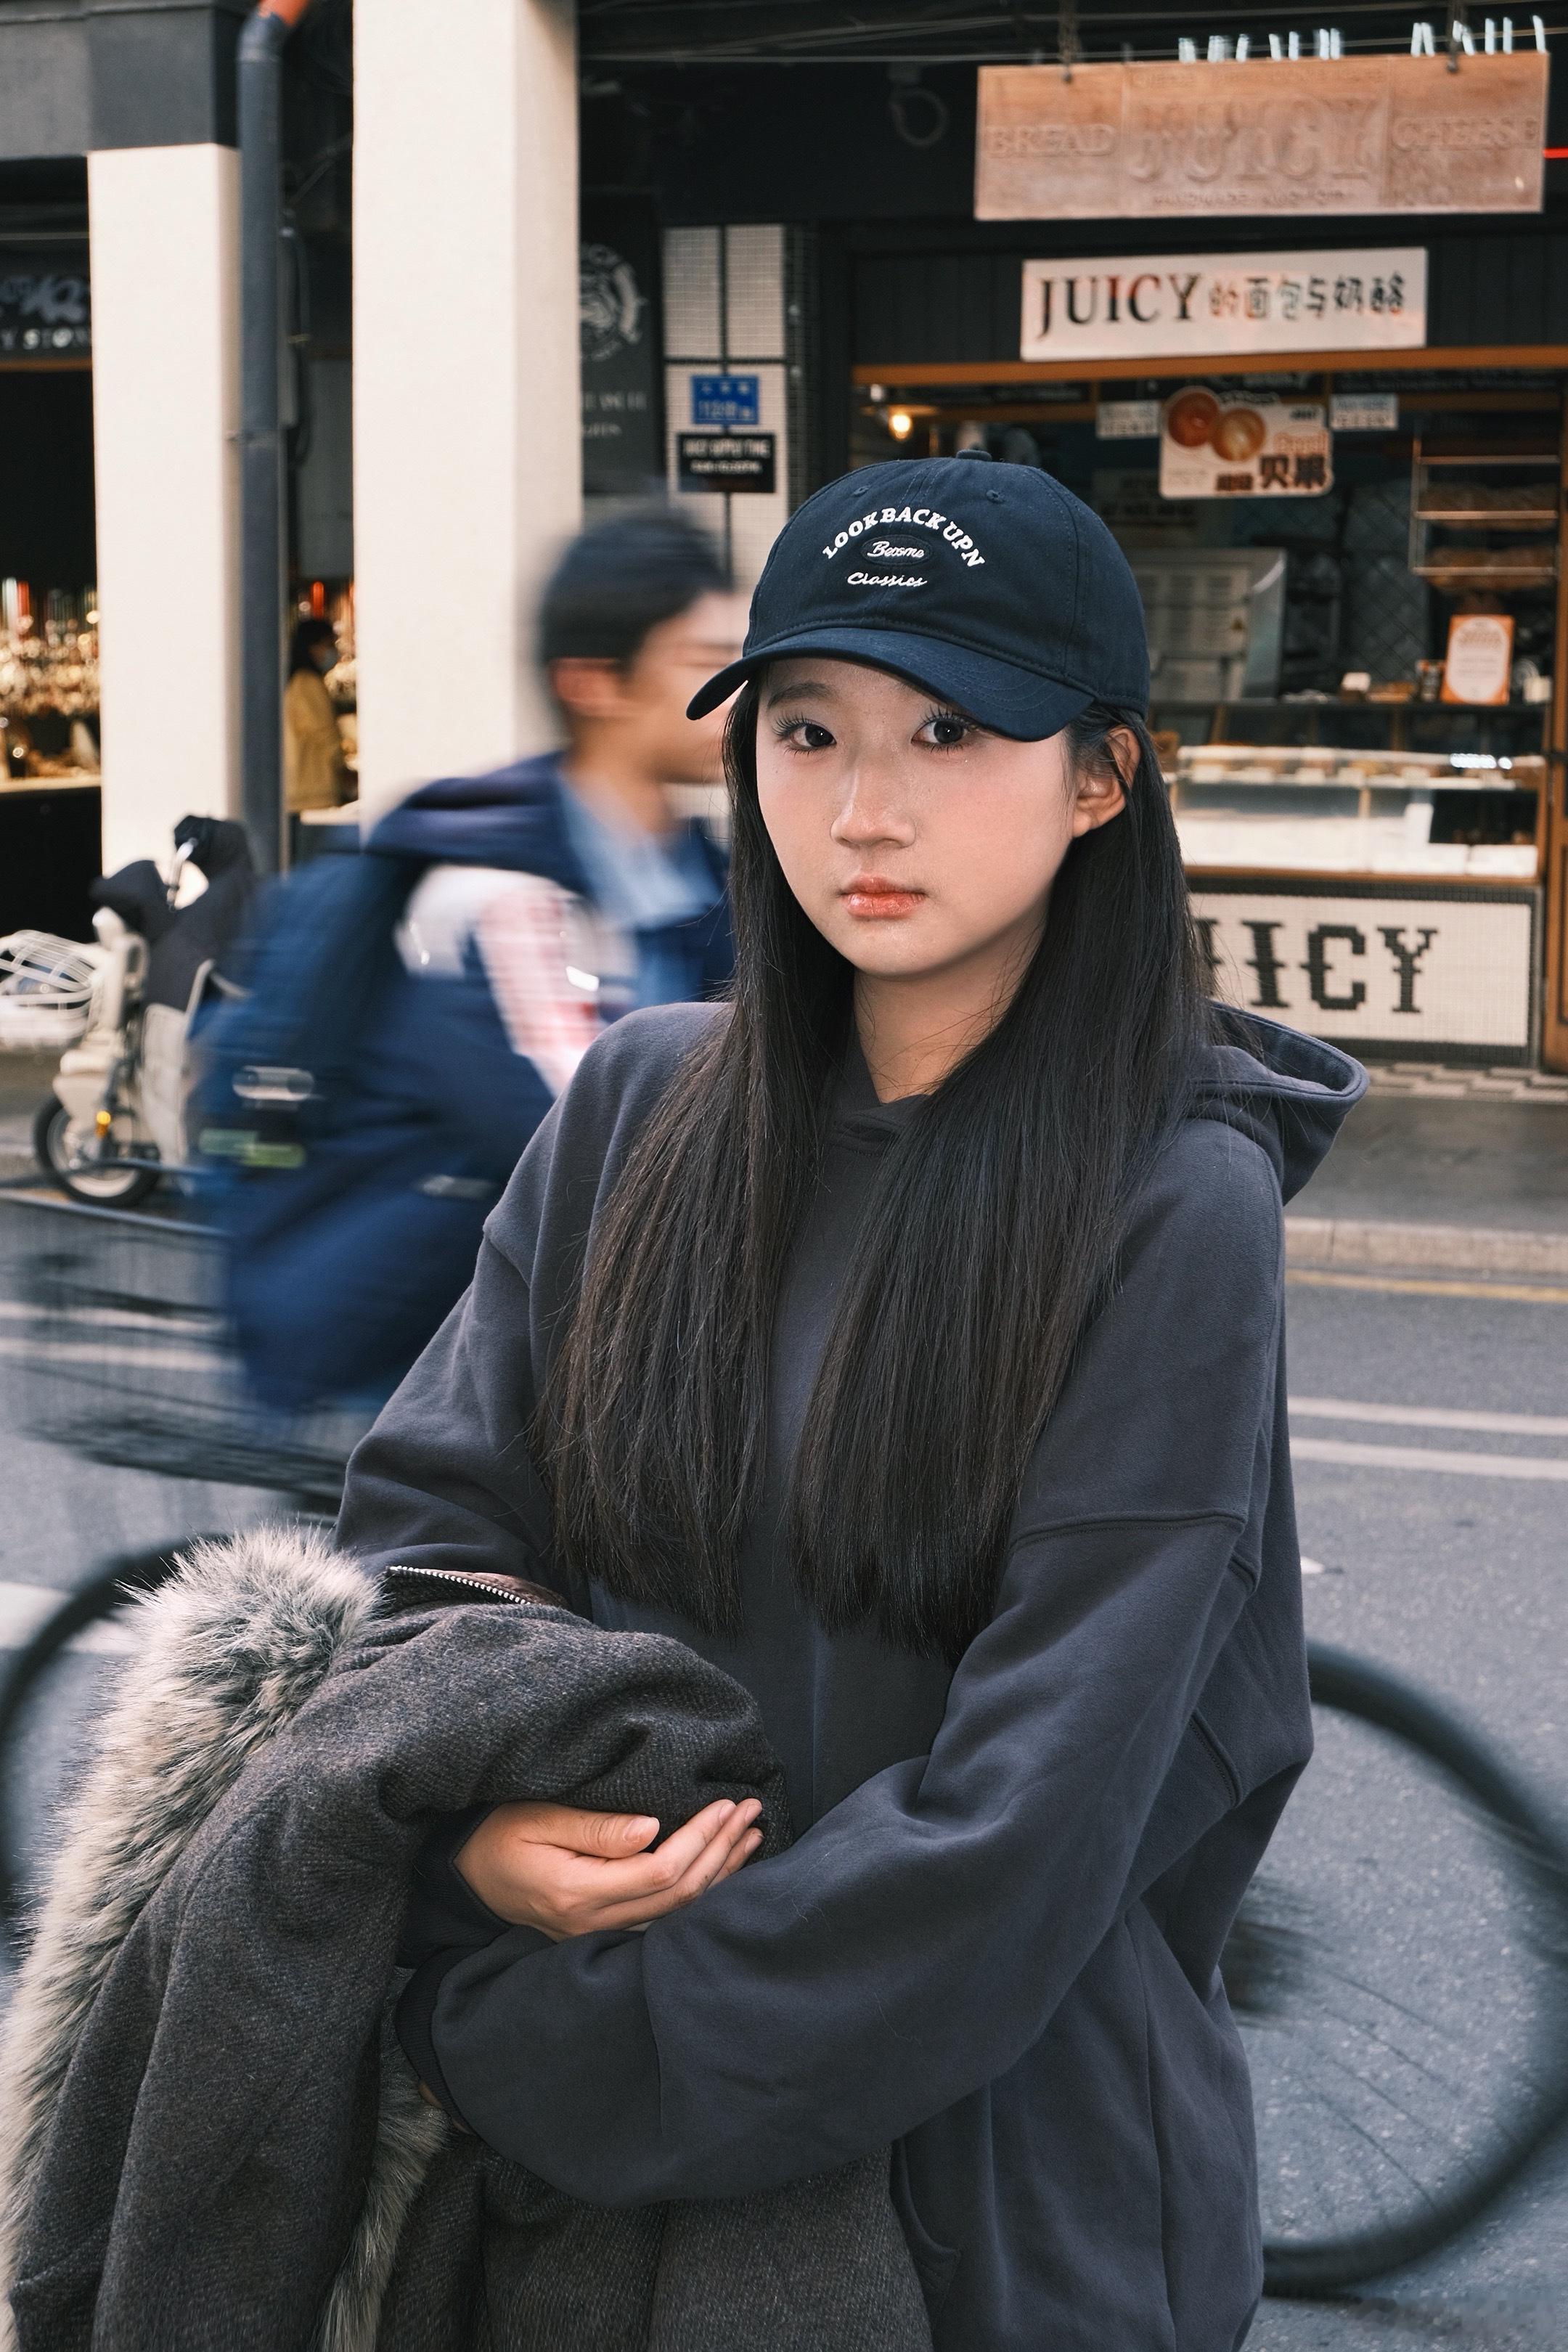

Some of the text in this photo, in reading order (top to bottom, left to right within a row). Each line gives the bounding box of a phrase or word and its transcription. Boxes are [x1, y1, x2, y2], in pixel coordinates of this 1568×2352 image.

[985, 124, 1117, 158] BREAD
[1035, 271, 1404, 341] JUICY 的面包与奶酪
[867, 541, 925, 558] Become
[847, 571, 928, 587] Classics
